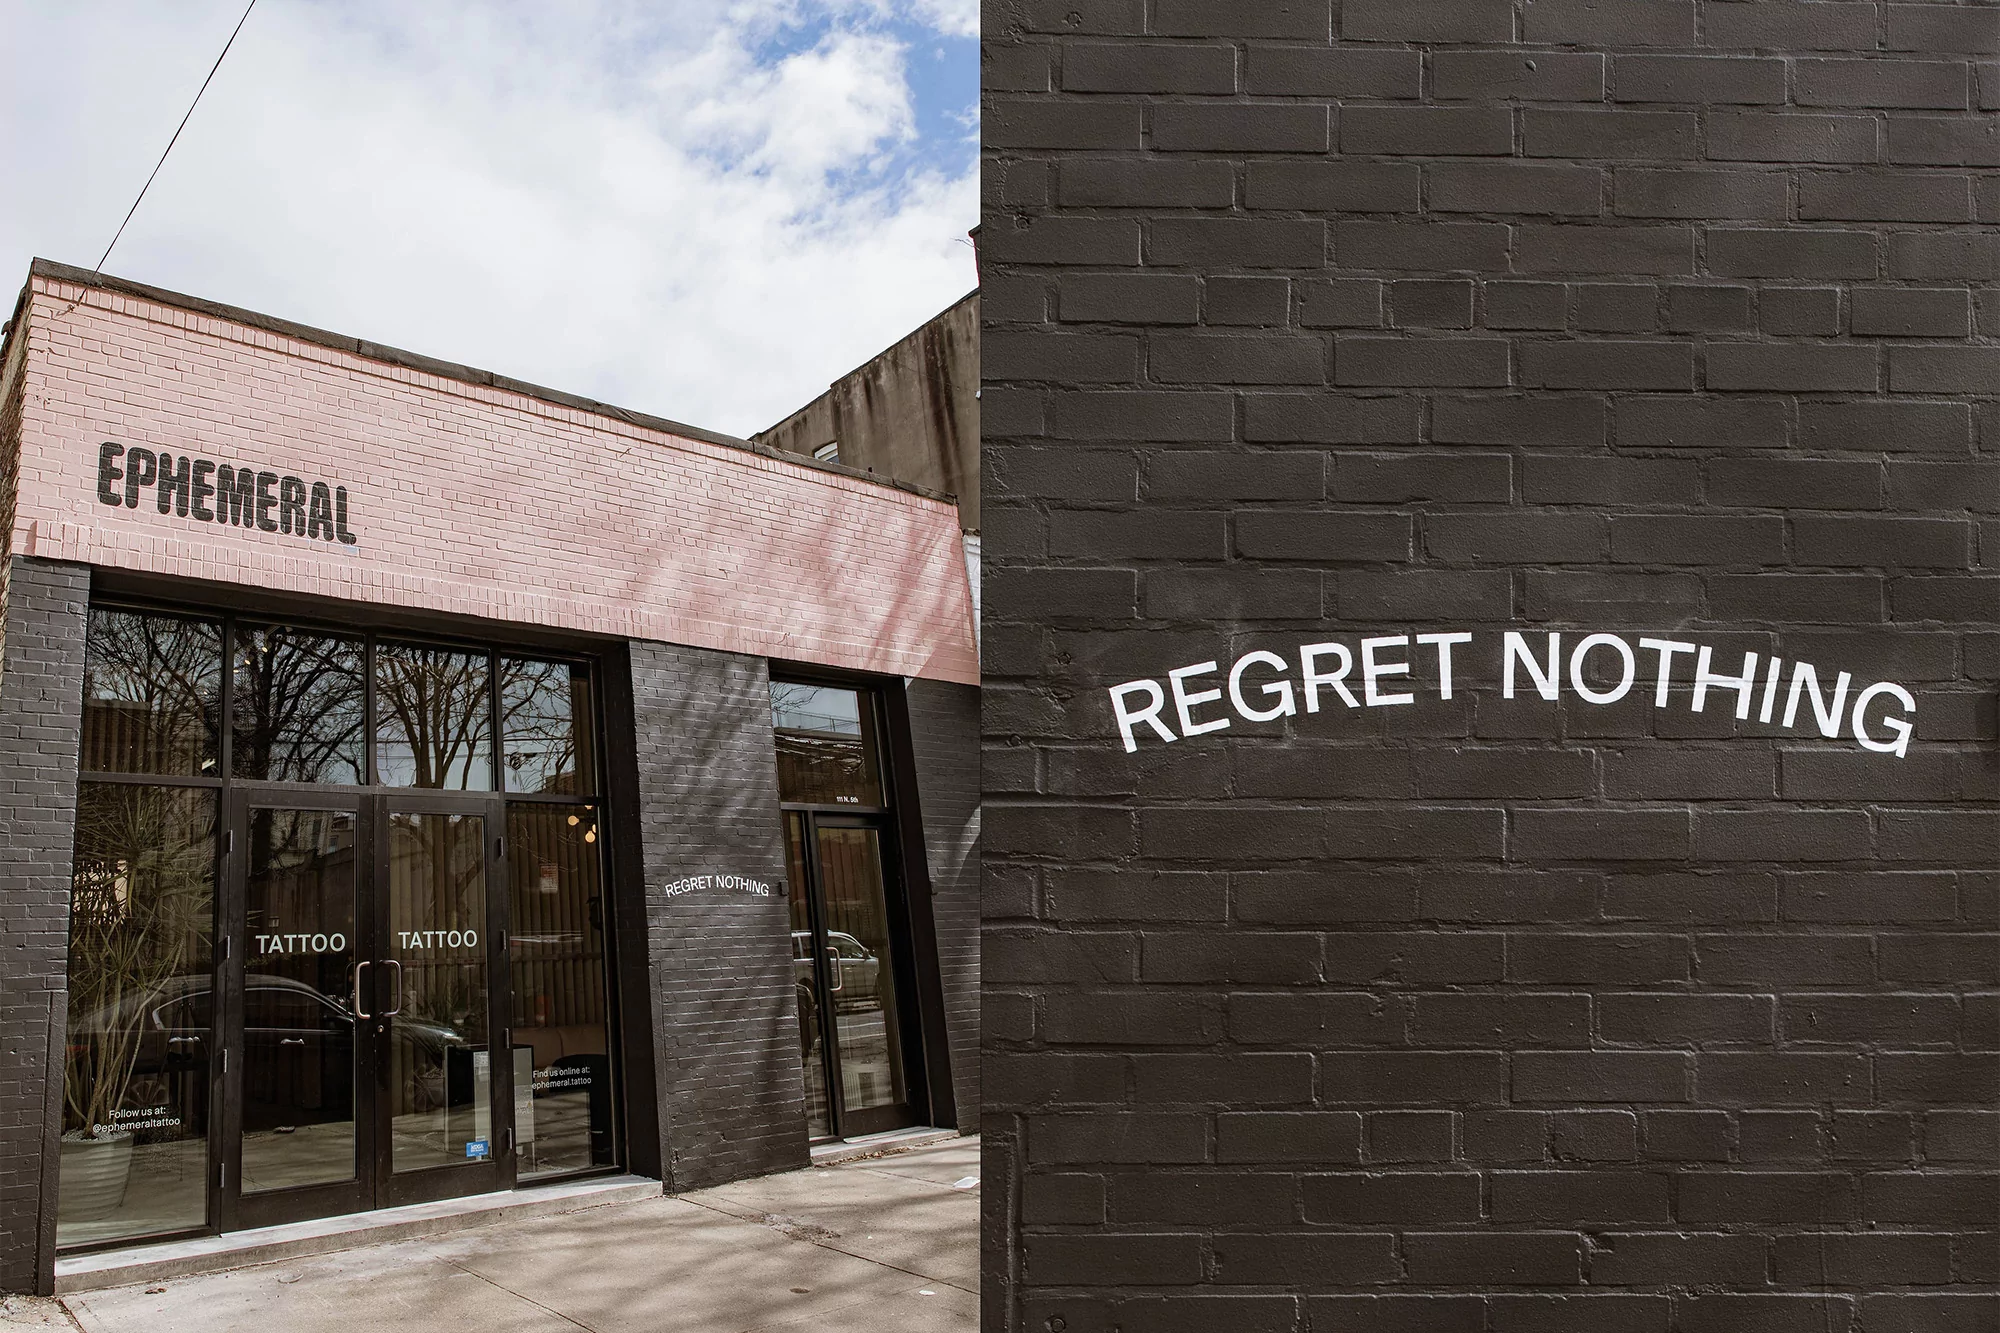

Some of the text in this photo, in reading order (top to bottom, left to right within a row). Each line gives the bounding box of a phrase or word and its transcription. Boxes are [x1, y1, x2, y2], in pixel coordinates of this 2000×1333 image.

[97, 441, 357, 545] EPHEMERAL
[1109, 631, 1917, 758] REGRET NOTHING
[665, 875, 769, 898] REGRET NOTHING
[255, 933, 346, 954] TATTOO
[398, 930, 478, 949] TATTOO
[532, 1070, 549, 1079] Find
[559, 1067, 580, 1076] online
[581, 1066, 591, 1074] at:
[531, 1077, 592, 1090] ephemeral.tattoo
[109, 1106, 166, 1119] Follow us at:
[92, 1118, 181, 1133] @ephemeraltattoo
